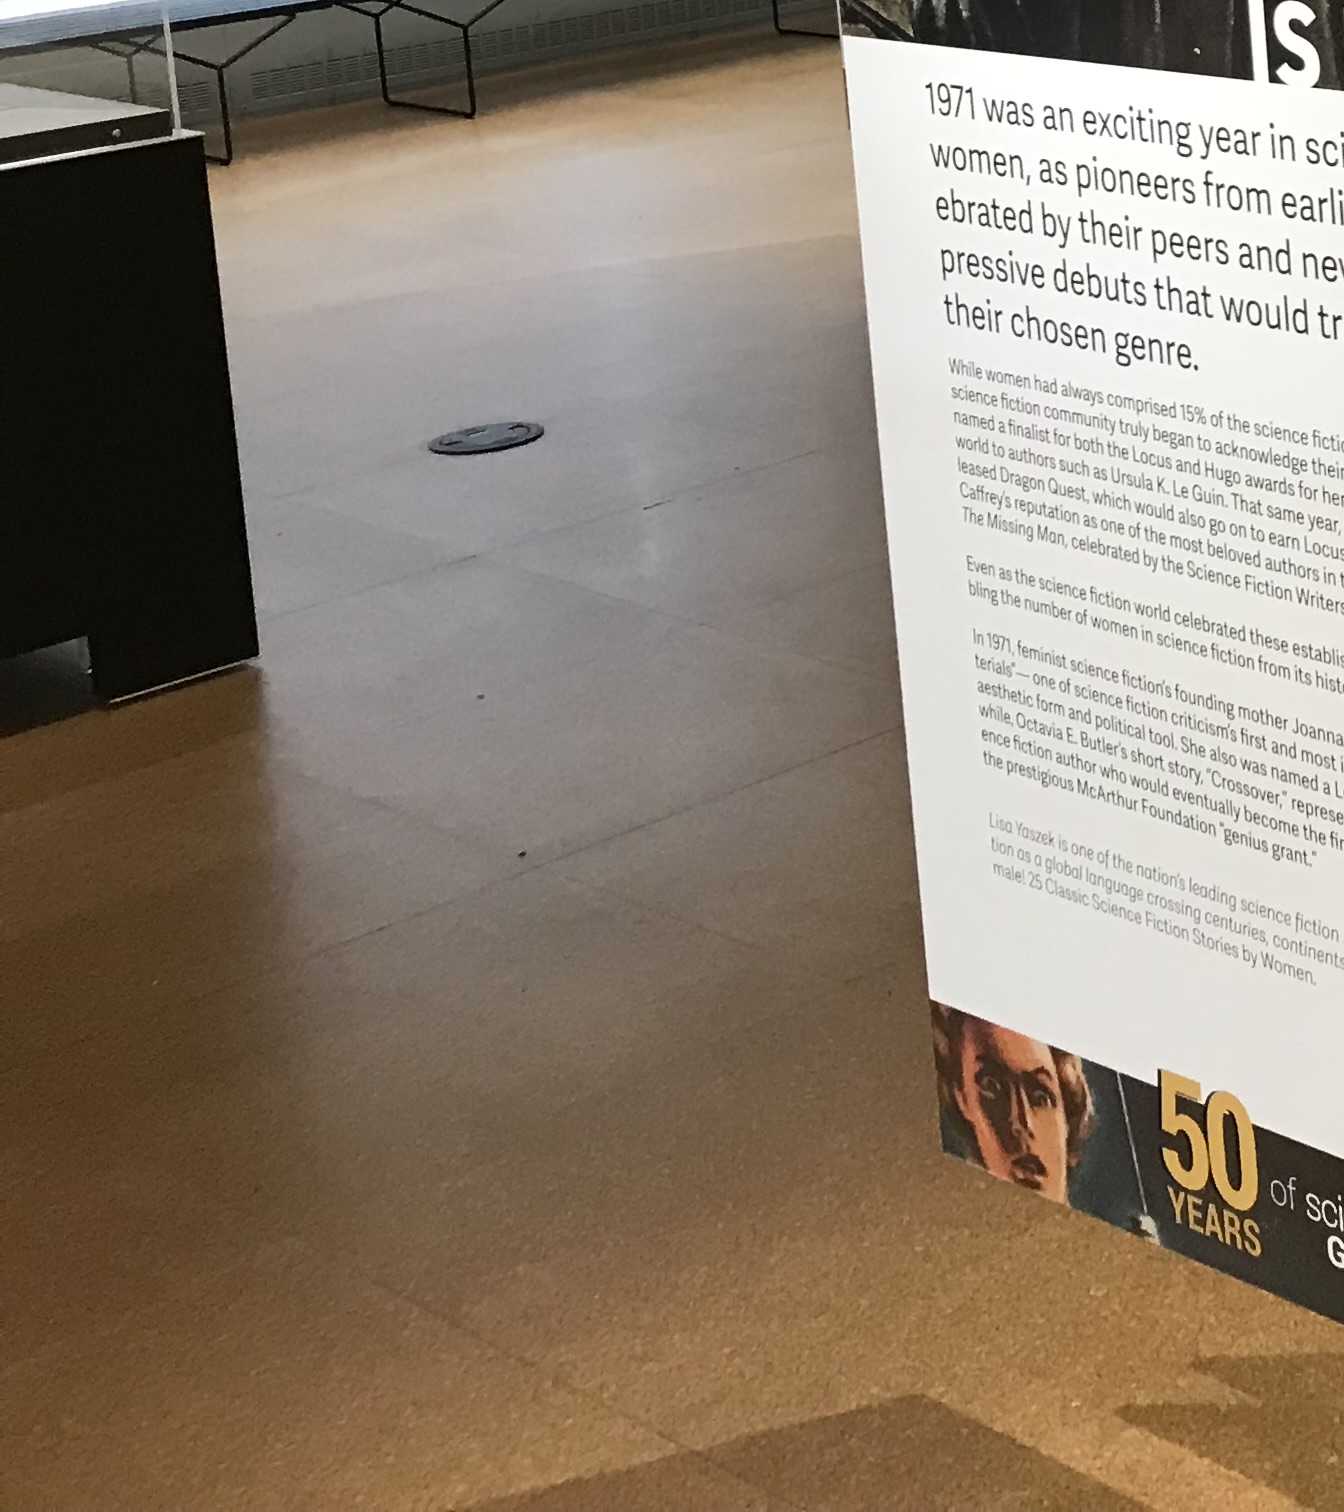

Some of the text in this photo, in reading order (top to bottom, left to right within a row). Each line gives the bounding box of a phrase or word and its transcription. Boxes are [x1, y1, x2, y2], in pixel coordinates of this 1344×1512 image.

[924, 81, 976, 120] 1971
[982, 97, 1035, 128] was
[1042, 105, 1075, 133] an
[1082, 105, 1193, 159] exciting
[1198, 124, 1262, 161] year
[1269, 122, 1296, 162] in
[929, 143, 1031, 186] women,
[1039, 158, 1069, 186] as
[1075, 155, 1196, 205] pioneers
[1202, 169, 1272, 216] from
[935, 187, 1034, 235] ebrated
[1040, 201, 1072, 250] by
[1077, 209, 1143, 251] their
[1151, 228, 1230, 266] peers
[1238, 238, 1292, 276] and
[940, 248, 1046, 290] pressive
[1053, 258, 1148, 307] debuts
[1153, 275, 1215, 319] that
[1219, 294, 1310, 336] would
[943, 292, 1199, 372] their chosen genre.
[947, 357, 983, 380] While
[984, 369, 1032, 390] women
[1033, 373, 1058, 395] had
[1060, 381, 1104, 407] always
[1106, 393, 1178, 419] comprised
[1179, 403, 1208, 426] 15%
[1209, 410, 1225, 429] of
[1226, 413, 1251, 434] the
[1253, 421, 1309, 446] science
[967, 579, 999, 607] bling
[1000, 588, 1021, 609] the
[1024, 598, 1073, 622] number
[1075, 608, 1088, 626] of
[1089, 615, 1139, 640] women
[1140, 623, 1154, 644] in
[1156, 631, 1208, 658] science
[1210, 641, 1256, 671] fiction
[1257, 654, 1292, 681] from
[1293, 664, 1313, 687] its
[992, 863, 1317, 986] male! 25 Classic Science Fiction Stories by Women.
[1157, 1068, 1259, 1212] 50
[1167, 1185, 1263, 1258] YEARS
[1270, 1176, 1297, 1210] of
